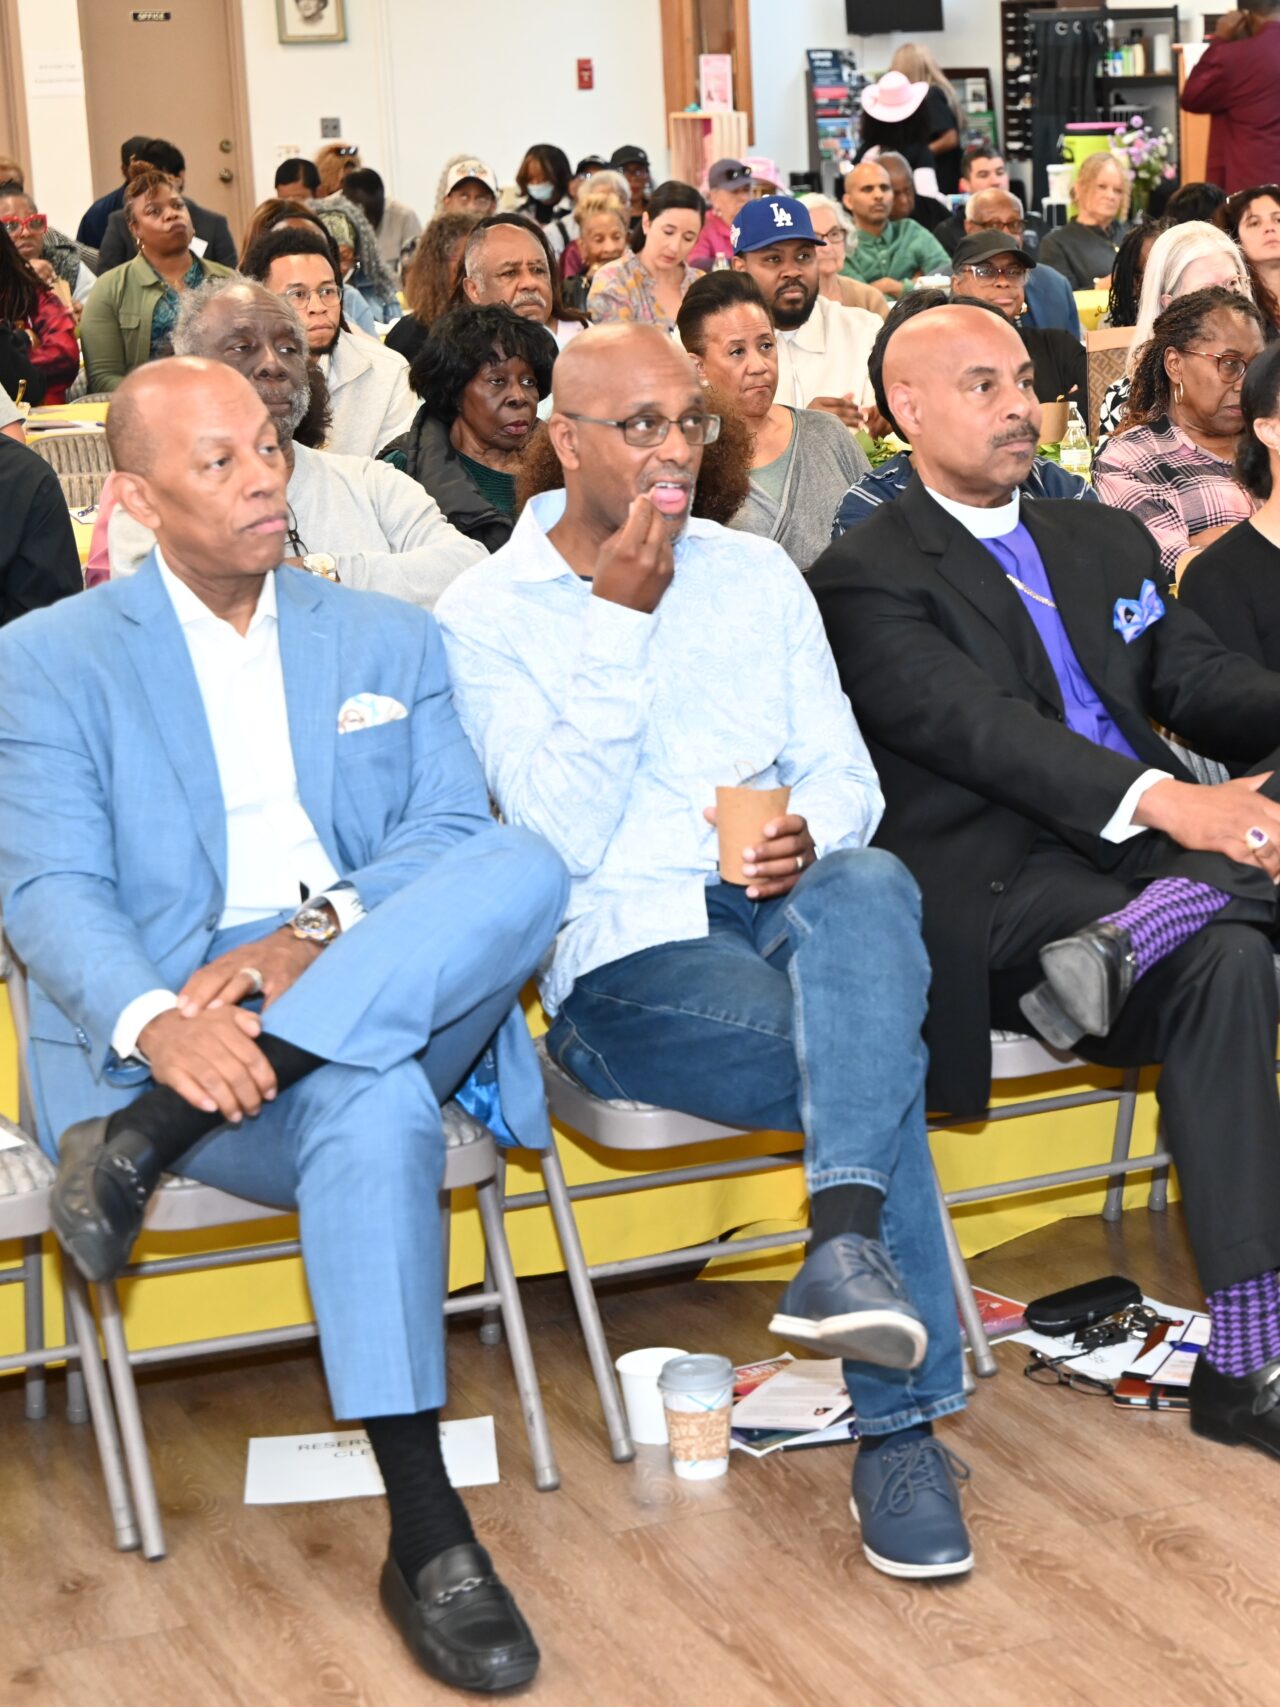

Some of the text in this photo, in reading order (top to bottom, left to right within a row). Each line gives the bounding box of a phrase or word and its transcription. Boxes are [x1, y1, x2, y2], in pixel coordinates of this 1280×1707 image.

[138, 12, 164, 20] OFFICE
[769, 203, 793, 227] LA
[298, 1439, 373, 1450] RESERV
